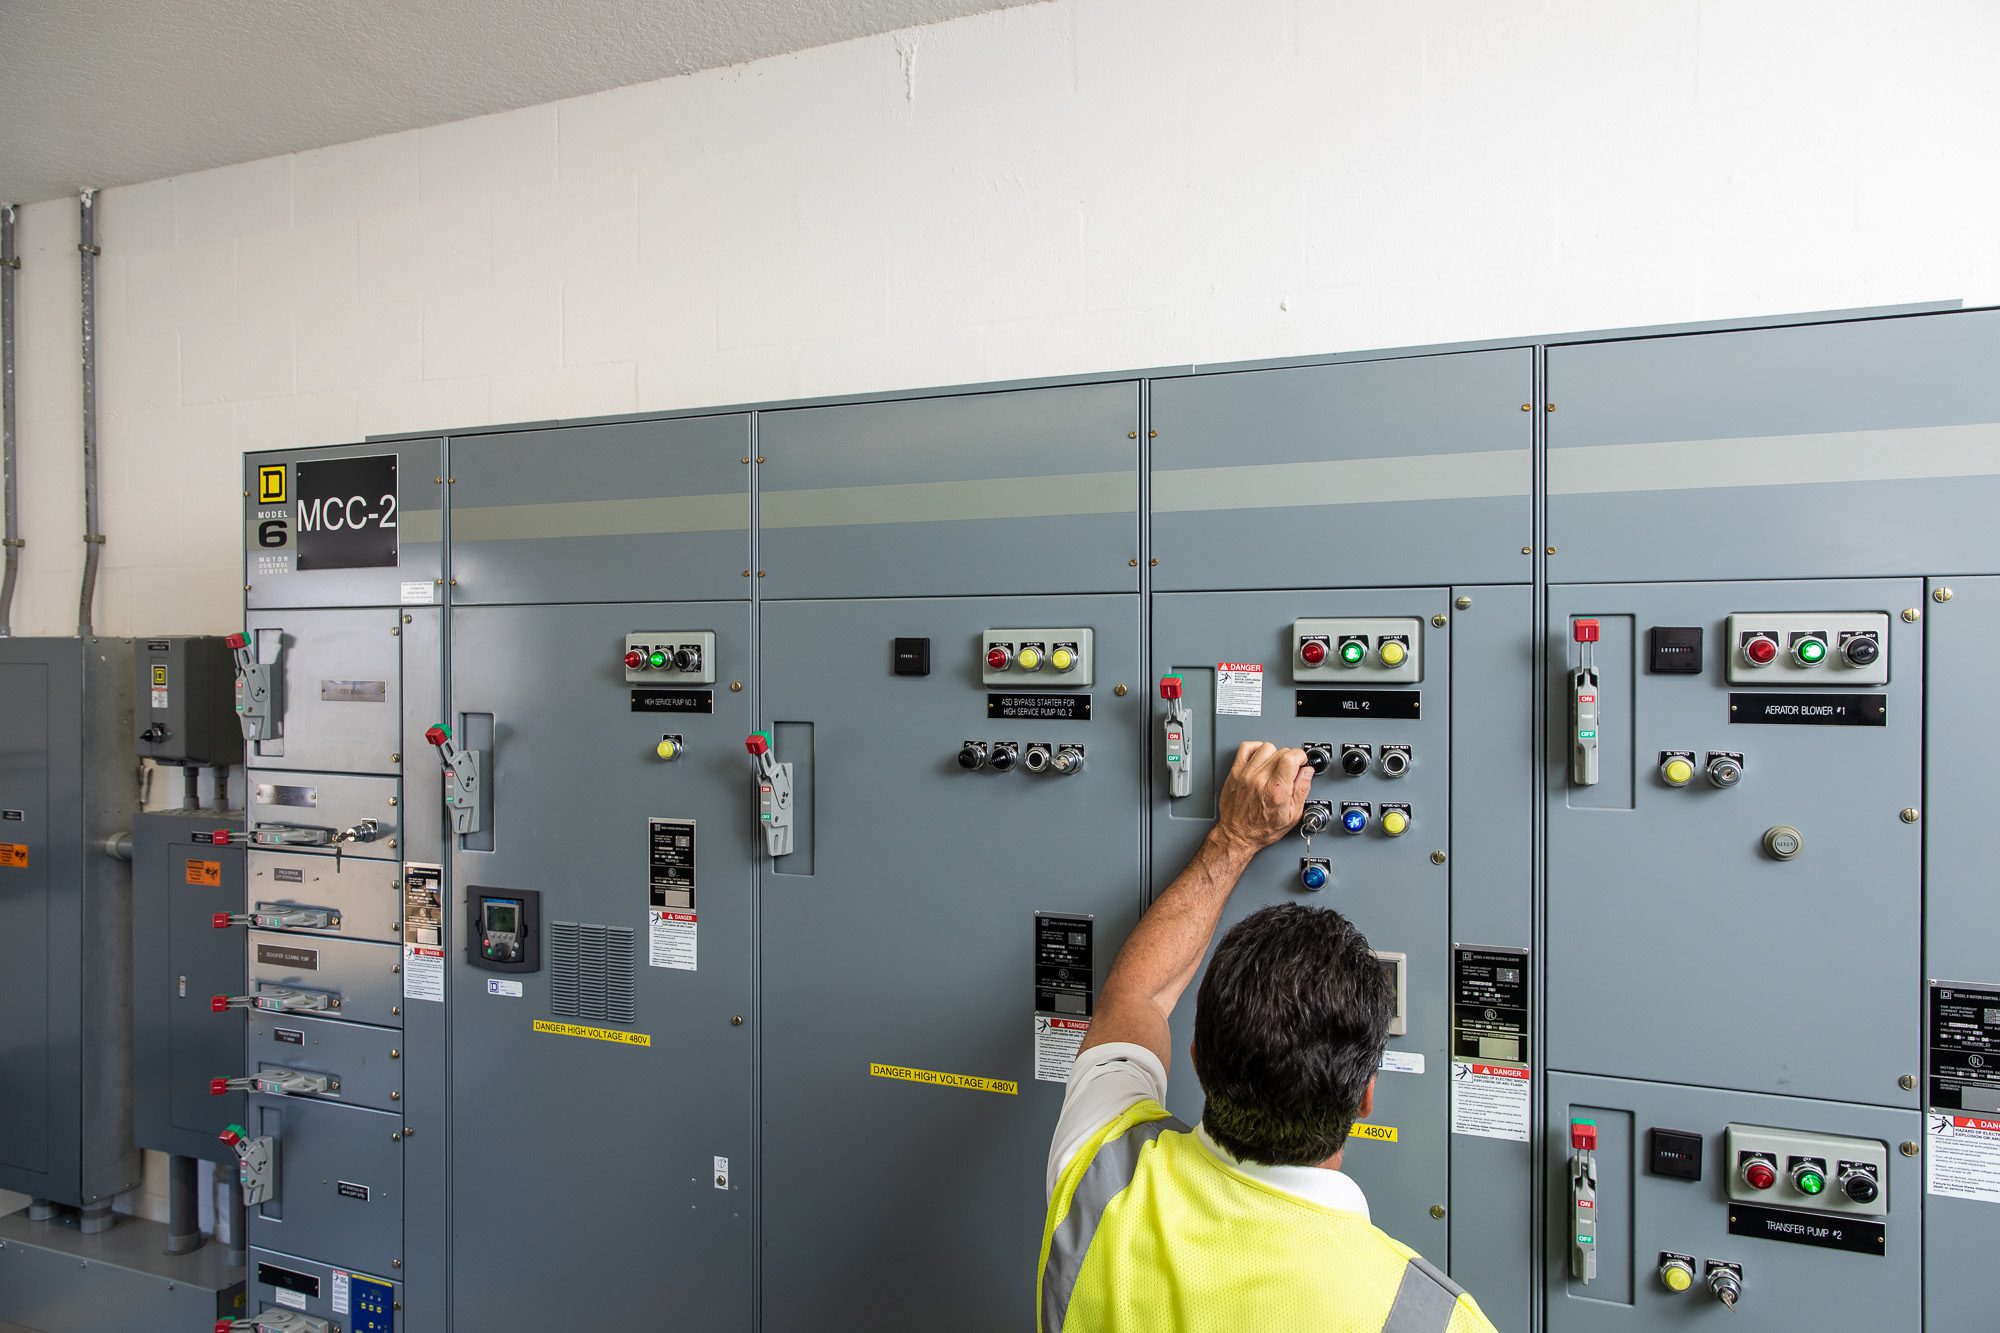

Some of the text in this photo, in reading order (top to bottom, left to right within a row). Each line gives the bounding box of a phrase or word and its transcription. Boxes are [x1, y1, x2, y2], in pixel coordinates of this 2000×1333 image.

[258, 510, 288, 519] MODEL
[297, 494, 396, 532] MCC-2
[258, 520, 287, 548] 6
[1342, 701, 1369, 710] WELL #2
[1765, 706, 1846, 715] AERATOR BLOWER #1
[535, 1022, 565, 1032] DANGER
[568, 1026, 586, 1035] HIGH
[588, 1028, 622, 1040] VOLTAGE
[629, 1032, 647, 1044] 480V
[874, 1066, 911, 1078] DANGER
[914, 1072, 936, 1082] HIGH
[940, 1075, 983, 1088] VOLTAGE
[992, 1082, 1014, 1092] 480V
[1494, 1068, 1522, 1077] DANGER
[1364, 1127, 1392, 1138] 480V
[1766, 1220, 1842, 1240] TRANSFER PUMP #2
